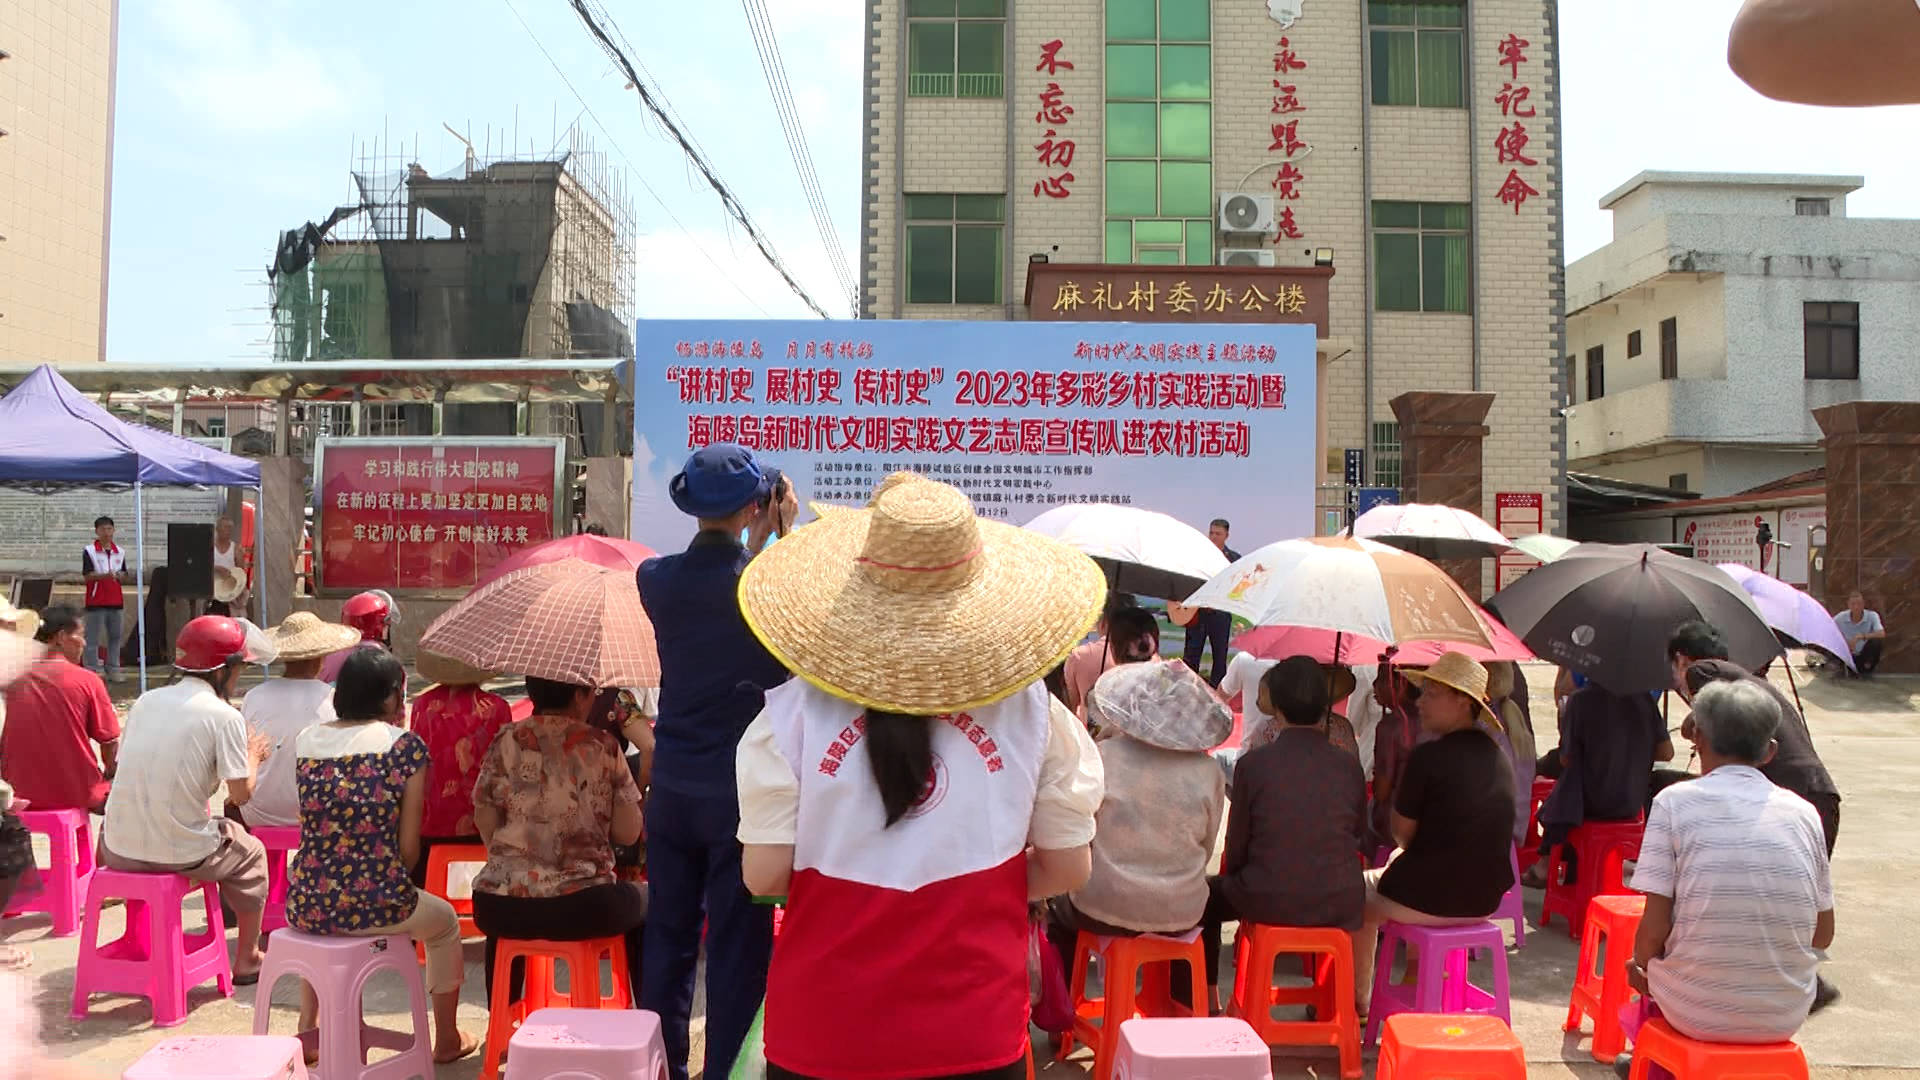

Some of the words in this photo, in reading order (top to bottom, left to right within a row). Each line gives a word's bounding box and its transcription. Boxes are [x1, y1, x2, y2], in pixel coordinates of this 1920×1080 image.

[1034, 39, 1075, 198] 不忘初心
[1494, 33, 1540, 216] 牢记使命
[1267, 37, 1307, 244] 永远跟党走
[1052, 280, 1307, 314] 麻礼村委办公楼
[1074, 341, 1277, 363] 新时代文明实践主题活动
[766, 367, 841, 404] 展村史
[955, 370, 1286, 409] 2023年多彩乡村实践活动暨
[688, 415, 1251, 457] 海陵岛新时代文明实践文艺志愿宣传队进农村活动
[364, 459, 520, 478] 学习和践行伟大建党精神
[337, 491, 548, 512] 在新的征程上更加坚定更加自觉地
[353, 524, 437, 543] 牢记初心使命
[444, 525, 529, 544] 开创美好未来
